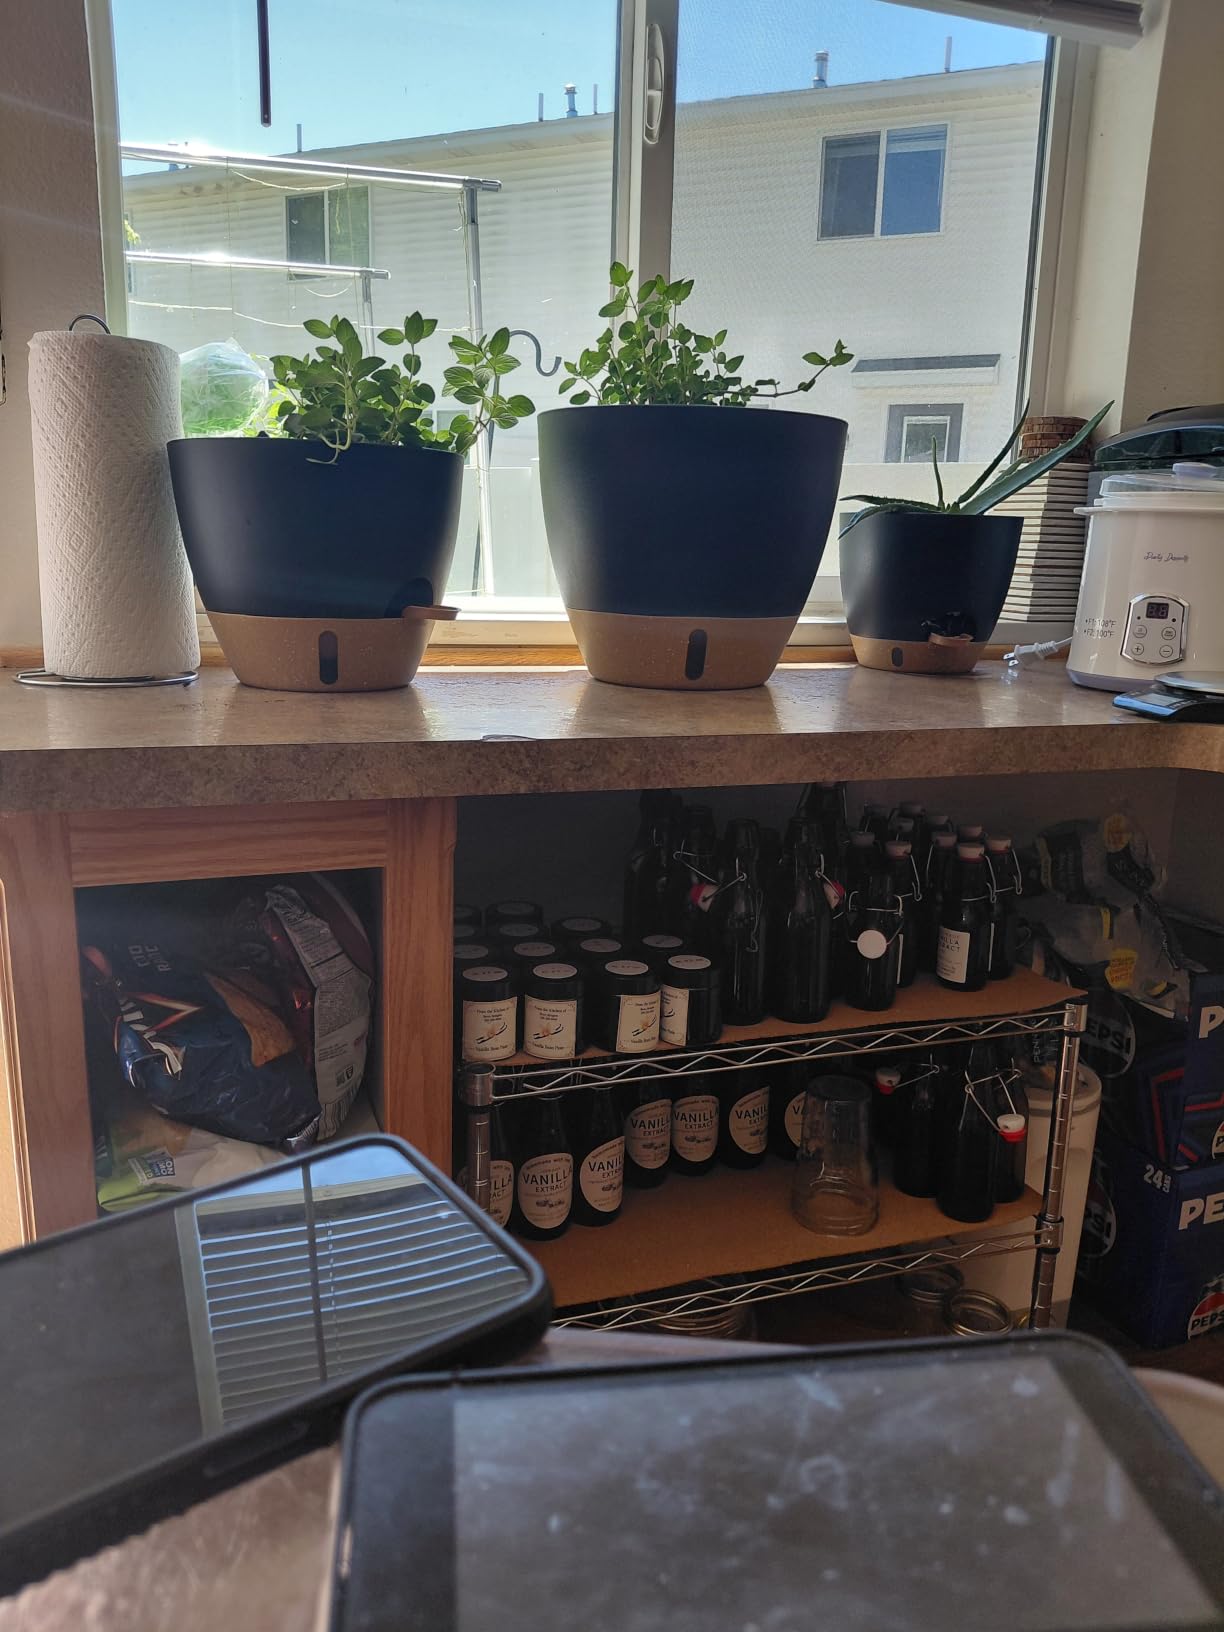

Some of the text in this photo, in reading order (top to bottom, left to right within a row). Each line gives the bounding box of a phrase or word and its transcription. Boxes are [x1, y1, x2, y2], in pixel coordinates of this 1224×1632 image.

[1087, 1018, 1132, 1055] EPSI
[522, 1164, 572, 1185] VANILLA
[535, 1180, 567, 1193] EXTRACT
